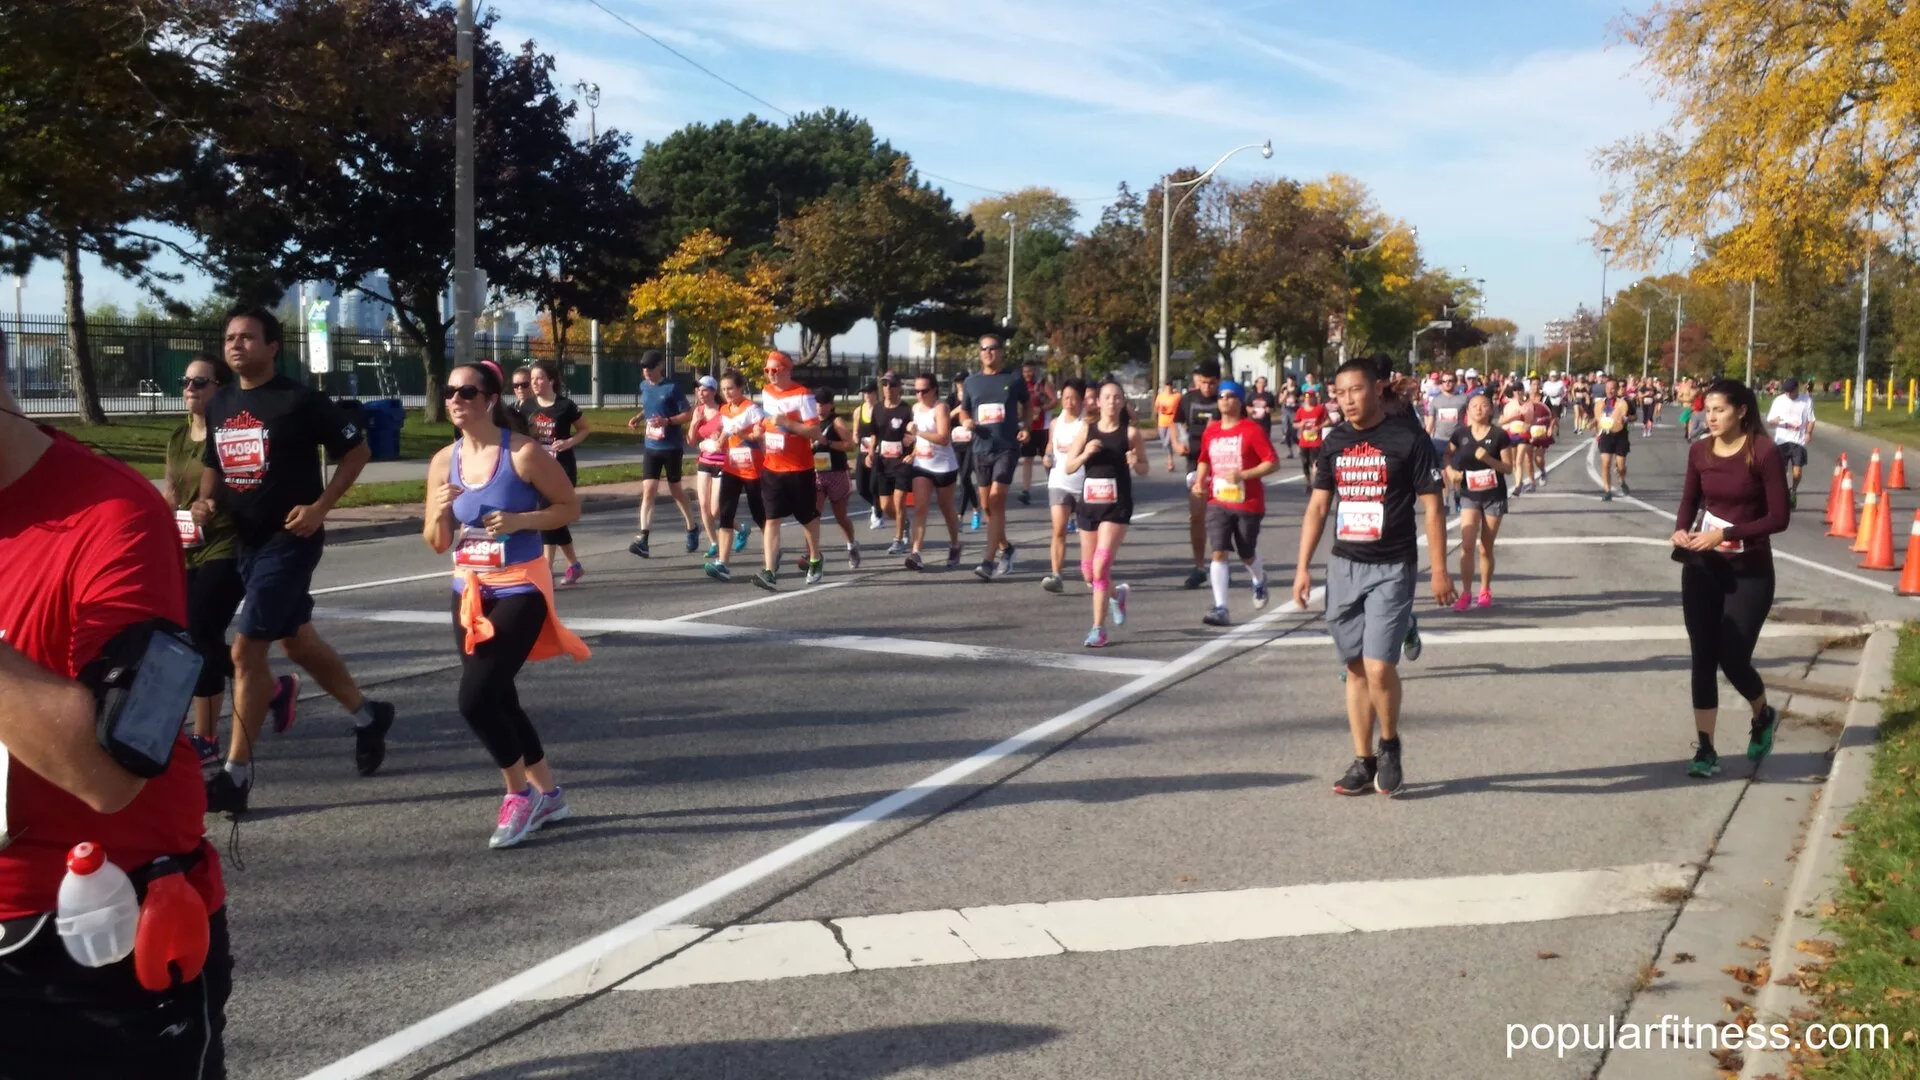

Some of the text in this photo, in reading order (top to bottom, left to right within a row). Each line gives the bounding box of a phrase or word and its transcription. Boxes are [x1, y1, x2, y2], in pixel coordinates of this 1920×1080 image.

[222, 441, 259, 457] 14080
[1336, 455, 1386, 467] SCOTIABANK
[1341, 471, 1379, 481] TORONTO
[1337, 485, 1387, 497] WATERFRONT
